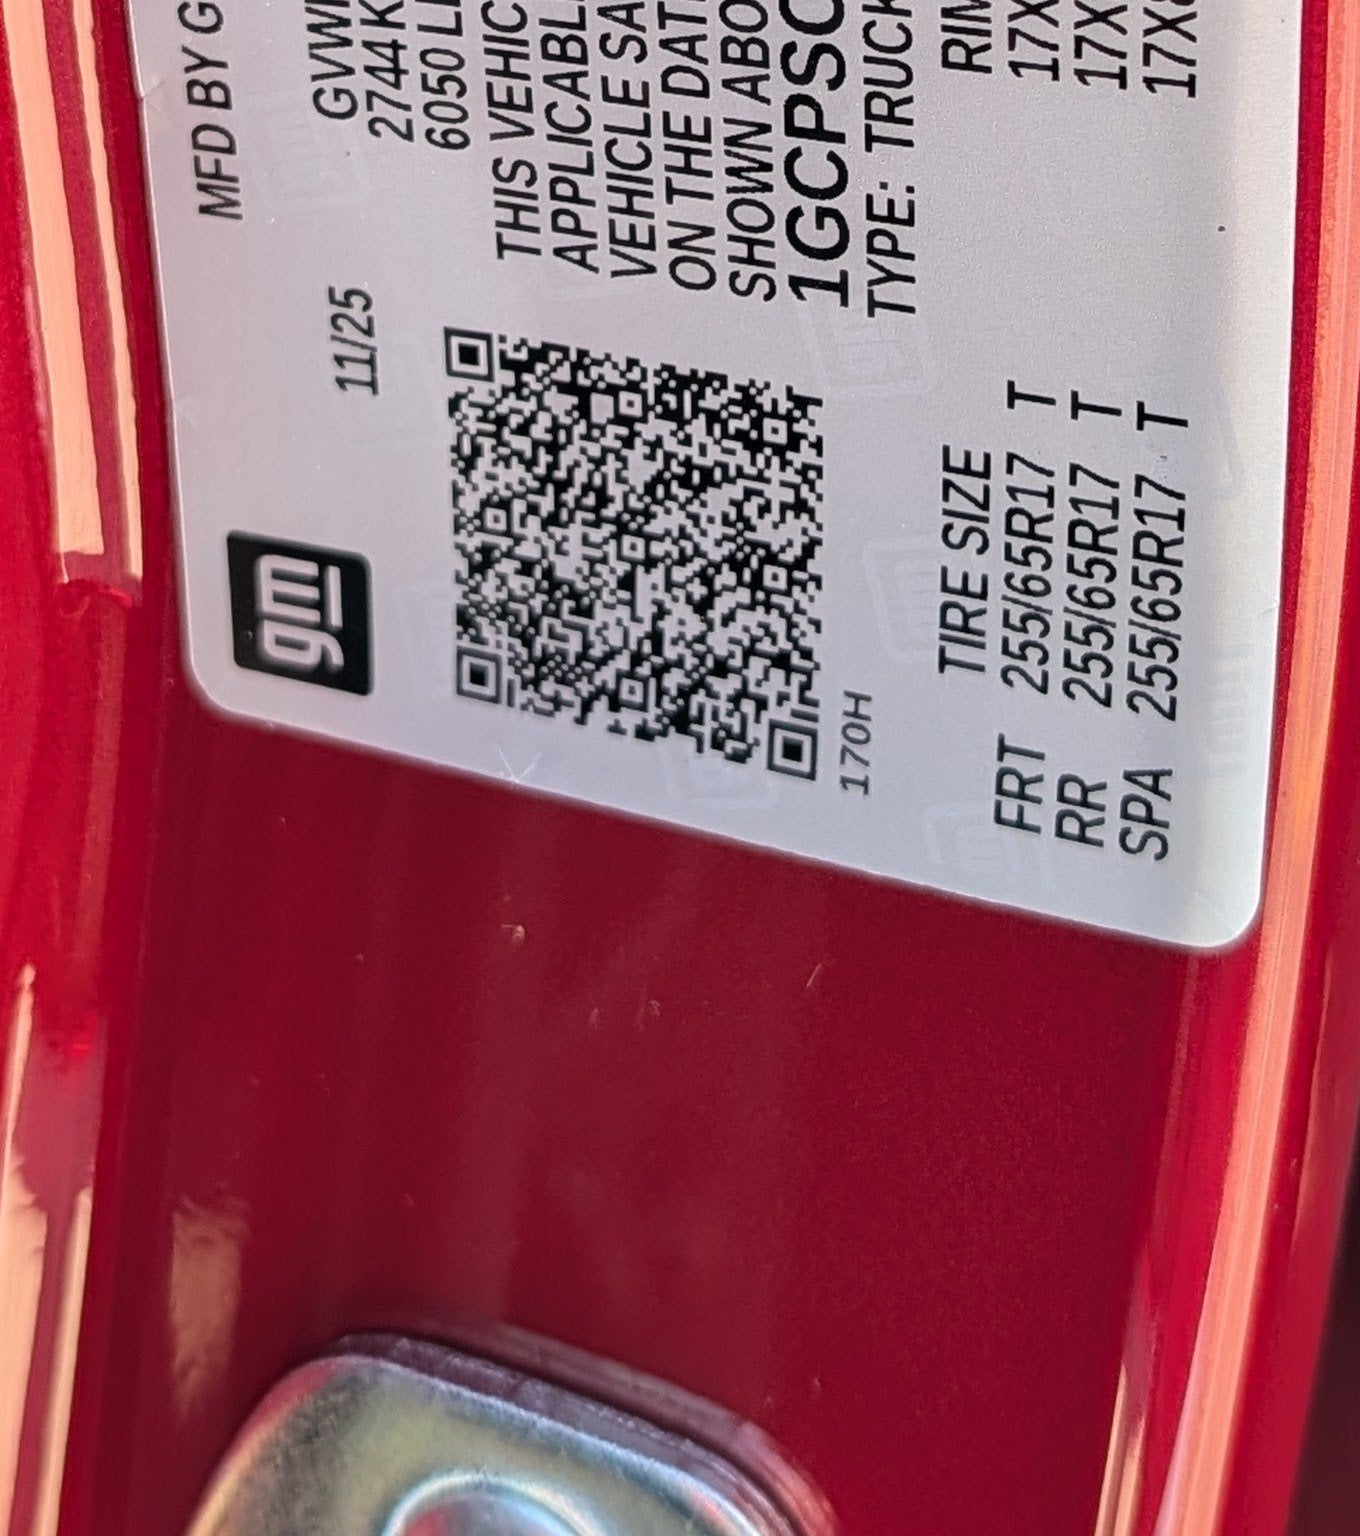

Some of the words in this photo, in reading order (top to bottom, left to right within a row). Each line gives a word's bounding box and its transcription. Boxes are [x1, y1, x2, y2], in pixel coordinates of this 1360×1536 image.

[181, 44, 233, 111] BY
[360, 38, 415, 143] 2744
[418, 47, 471, 151] 6050
[190, 122, 243, 221] MFD
[491, 156, 543, 261] THIS
[600, 74, 658, 279] VEHICLE
[661, 110, 715, 206] THE
[722, 116, 777, 303] SHOWN
[666, 219, 718, 292] ON
[865, 181, 917, 319] TYPE:
[327, 285, 379, 397] 11/25
[1006, 379, 1057, 410] T
[1070, 389, 1123, 421] T
[1135, 400, 1189, 432] T
[940, 444, 992, 556] SIZE
[259, 554, 344, 667] gm
[937, 564, 989, 675] TIRE
[999, 451, 1056, 696] 255/65R17
[1061, 461, 1121, 709] 255/65R17
[1125, 473, 1187, 723] 255/65R17
[839, 690, 873, 796] 170H
[993, 733, 1046, 835] FRT
[1054, 773, 1108, 848] RR
[1118, 768, 1174, 862] SPA
